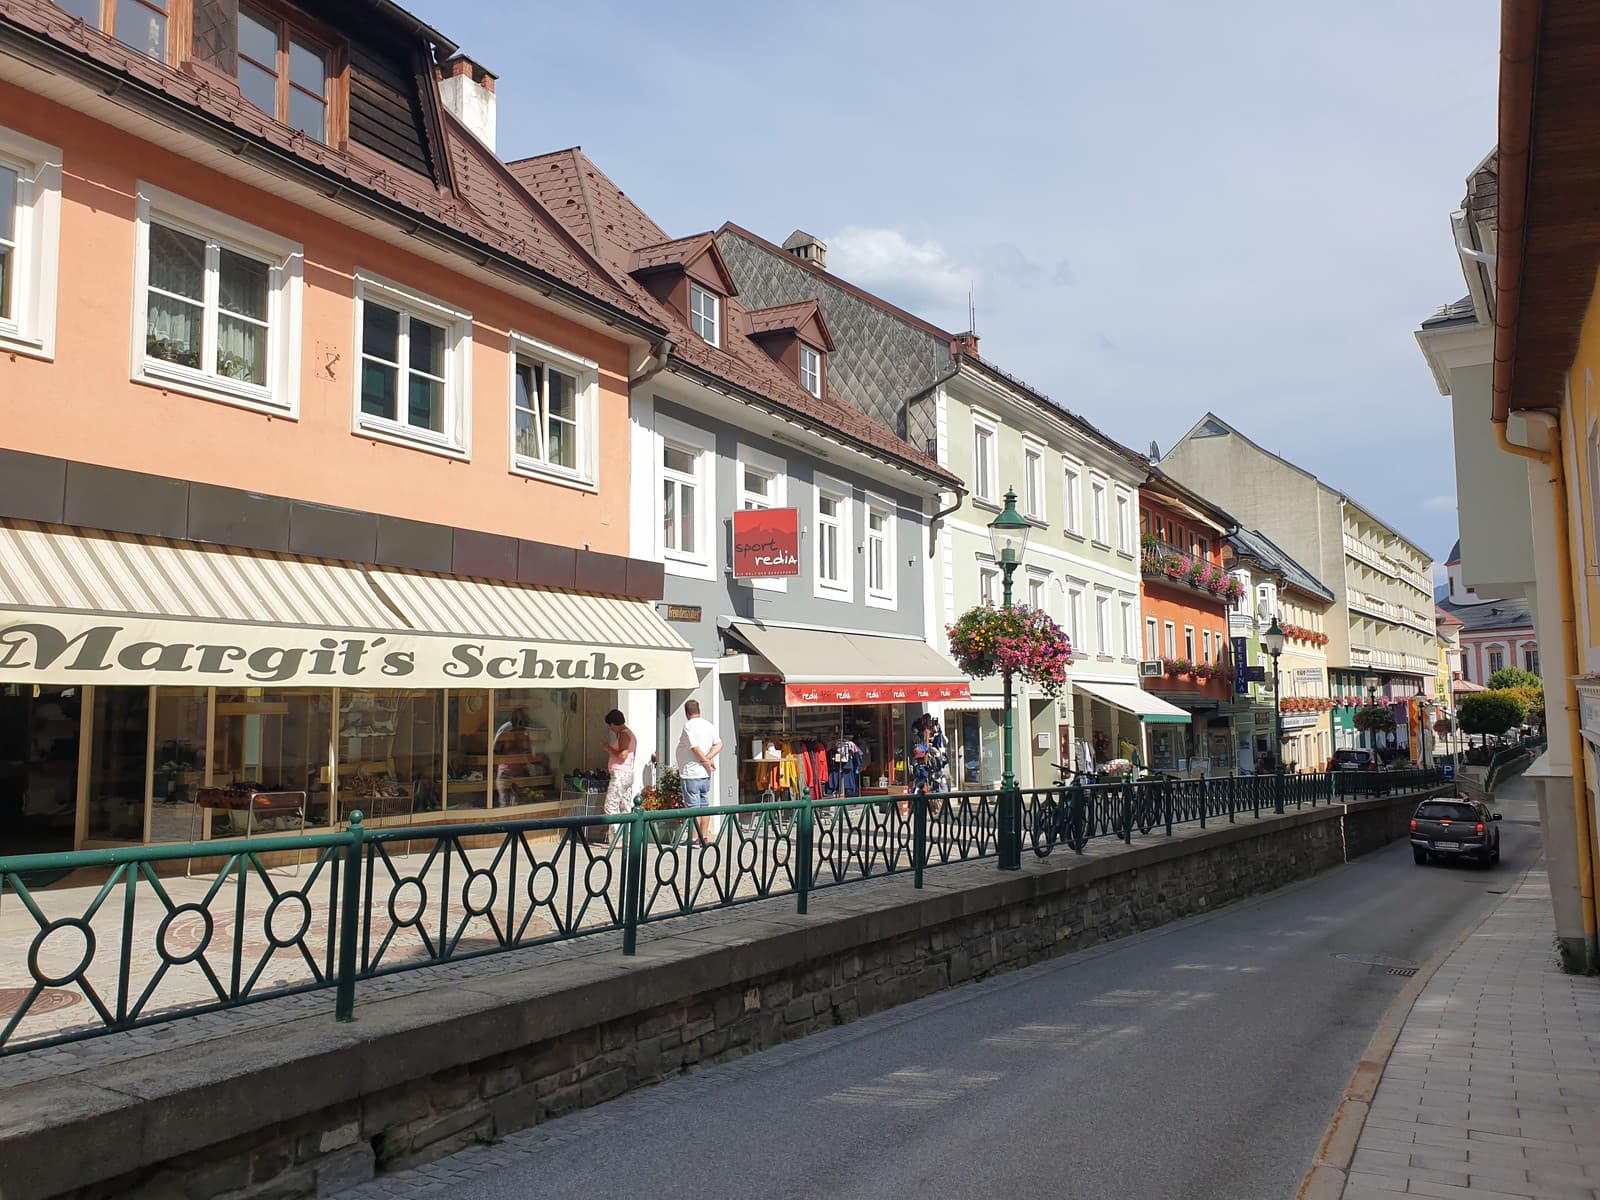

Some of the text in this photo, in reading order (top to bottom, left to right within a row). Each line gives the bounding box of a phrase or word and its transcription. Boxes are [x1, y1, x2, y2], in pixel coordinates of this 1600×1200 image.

[735, 538, 778, 559] sport
[754, 549, 798, 567] redia
[0, 623, 646, 682] Margit's Schuhe
[1237, 638, 1245, 692] FESTINA
[1443, 765, 1453, 775] P
